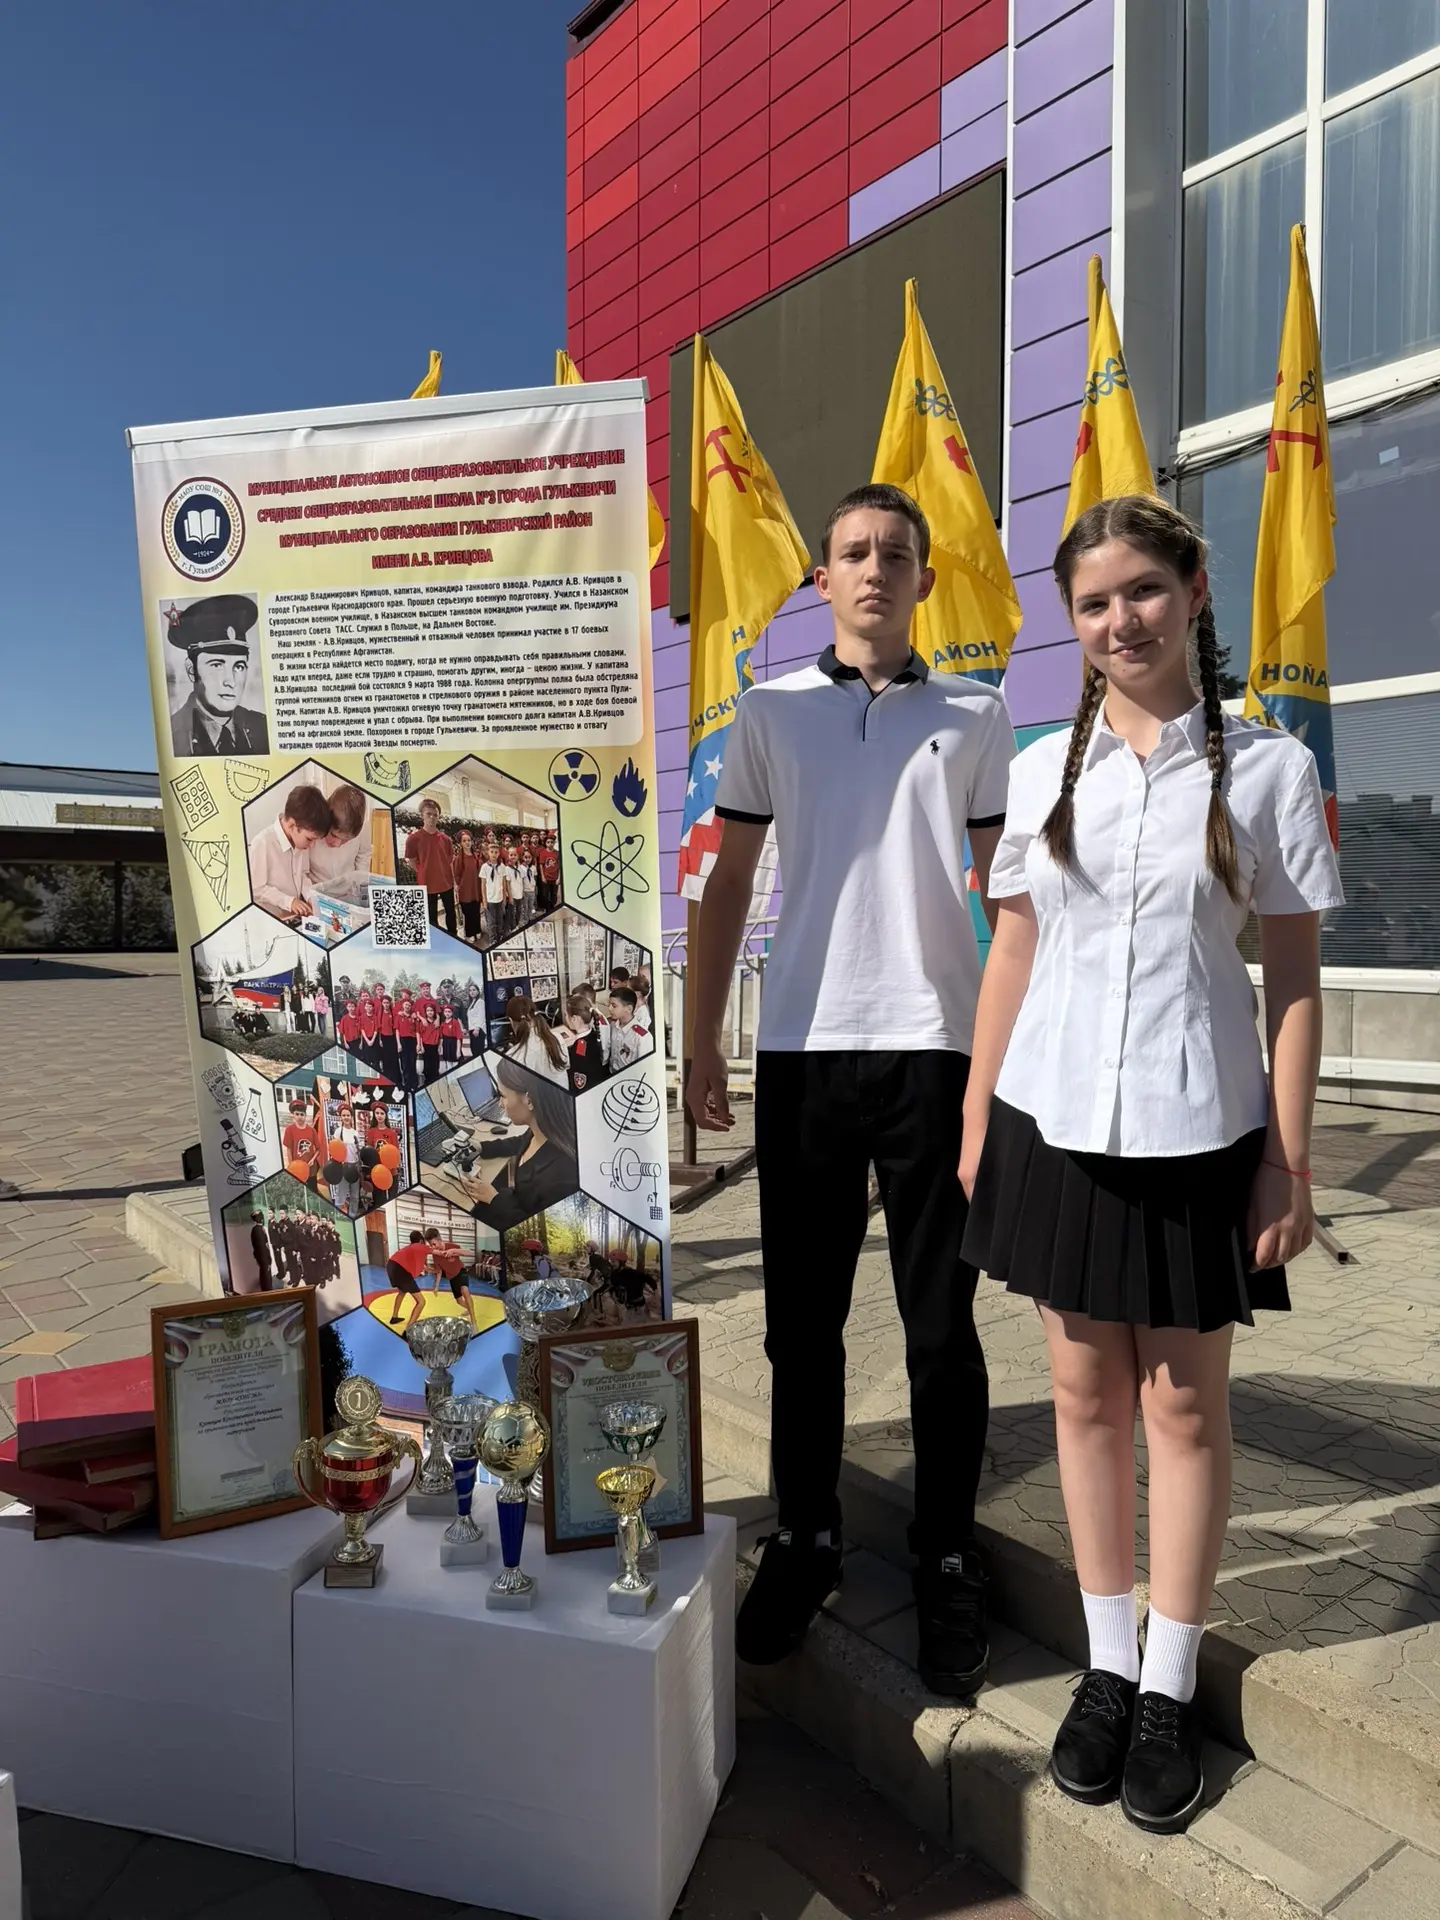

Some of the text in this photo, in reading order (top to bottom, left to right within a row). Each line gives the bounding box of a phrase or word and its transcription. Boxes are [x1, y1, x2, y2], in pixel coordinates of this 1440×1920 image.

[248, 449, 625, 496] МУНИЦИПАЛЬНОЕ АВТОНОМНОЕ ОБЩЕОБРАЗОВАТЕЛЬНОЕ УЧРЕЖДЕНИЕ
[257, 505, 303, 523] СРЕДНЯЯ
[304, 495, 432, 519] ОБЩЕОБРАЗОВАТЕЛЬНАЯ
[434, 494, 475, 508] ШКОЛА
[497, 485, 542, 504] ГОРОДА
[542, 480, 617, 500] ГУЛЬКЕВИЧИ
[380, 521, 458, 540] ОБРАЗОВАНИЯ
[460, 512, 552, 536] ГУЛЬКЕВИЧСКИЙ
[554, 510, 593, 529] РАЙОН
[372, 548, 493, 569] ИМЕНИ А.В. КРИВЦОВА
[275, 593, 308, 602] Александр
[310, 591, 358, 600] Владимирович
[425, 584, 463, 593] командира
[465, 582, 500, 591] танкового
[532, 578, 563, 588] Родился
[582, 575, 614, 586] Кривцов
[268, 606, 290, 614] городе
[291, 604, 329, 614] Гулькевичи
[331, 600, 384, 611] Краснодарского
[407, 597, 435, 607] Прошел
[436, 596, 473, 605] серьезную
[475, 594, 506, 603] военную
[553, 590, 580, 598] Учился
[589, 587, 628, 596] Казанском
[268, 617, 309, 626] Суворовском
[311, 615, 339, 623] военном
[380, 611, 417, 619] Казанском
[418, 609, 447, 617] высшем
[449, 607, 481, 616] танковом
[483, 605, 523, 614] командном
[525, 603, 557, 613] училище
[574, 600, 618, 610] Президиума
[269, 628, 307, 637] Верховного
[308, 626, 331, 635] Совета
[356, 624, 382, 633] Служил
[432, 620, 463, 630] Дальнем
[293, 639, 316, 647] земляк
[368, 633, 419, 644] мужественный
[428, 631, 463, 641] отважный
[465, 631, 495, 639] человек
[497, 629, 531, 638] принимал
[533, 627, 562, 637] участие
[571, 625, 579, 634] 17
[580, 625, 608, 634] боевых
[312, 648, 351, 658] Республике
[364, 659, 383, 667] место
[417, 657, 436, 665] когда
[449, 655, 471, 664] нужно
[473, 654, 520, 663] оправдывать
[522, 652, 539, 660] себя
[541, 650, 591, 661] правильными
[934, 640, 998, 668] АЙОН
[272, 674, 289, 682] Надо
[290, 674, 305, 682] идти
[334, 672, 352, 680] даже
[354, 671, 370, 679] если
[371, 670, 395, 679] трудно
[499, 665, 524, 673] иногда
[594, 661, 628, 669] капитана
[321, 683, 356, 692] последний
[358, 682, 370, 690] бой
[372, 682, 405, 690] состоялся
[414, 681, 434, 689] марта
[436, 678, 452, 687] 1988
[474, 677, 504, 686] Колонна
[506, 676, 549, 686] опергруппы
[551, 675, 572, 683] полка
[574, 674, 594, 682] была
[596, 672, 638, 682] обстреляна
[374, 693, 420, 702] гранатометов
[428, 691, 471, 700] стрелкового
[473, 690, 500, 699] оружия
[536, 687, 581, 695] населенного
[583, 685, 608, 695] пункта
[299, 707, 325, 715] Капитан
[342, 705, 371, 714] Кривцов
[372, 705, 409, 714] уничтожил
[463, 701, 507, 711] гранатомета
[575, 698, 593, 706] ходе
[595, 696, 609, 705] боя
[610, 695, 637, 704] боевой
[292, 719, 319, 727] получил
[320, 718, 365, 726] повреждение
[426, 714, 440, 724] При
[441, 714, 484, 722] выполнении
[524, 712, 545, 720] долга
[307, 729, 341, 738] афганской
[366, 727, 402, 736] Похоронен
[410, 727, 434, 735] городе
[539, 723, 574, 732] мужество
[583, 721, 607, 730] отвагу
[278, 742, 313, 750] награжден
[314, 741, 342, 749] орденом
[344, 739, 371, 748] Красной
[373, 739, 398, 747] Звезды
[198, 1335, 274, 1358] ГРАМОТА
